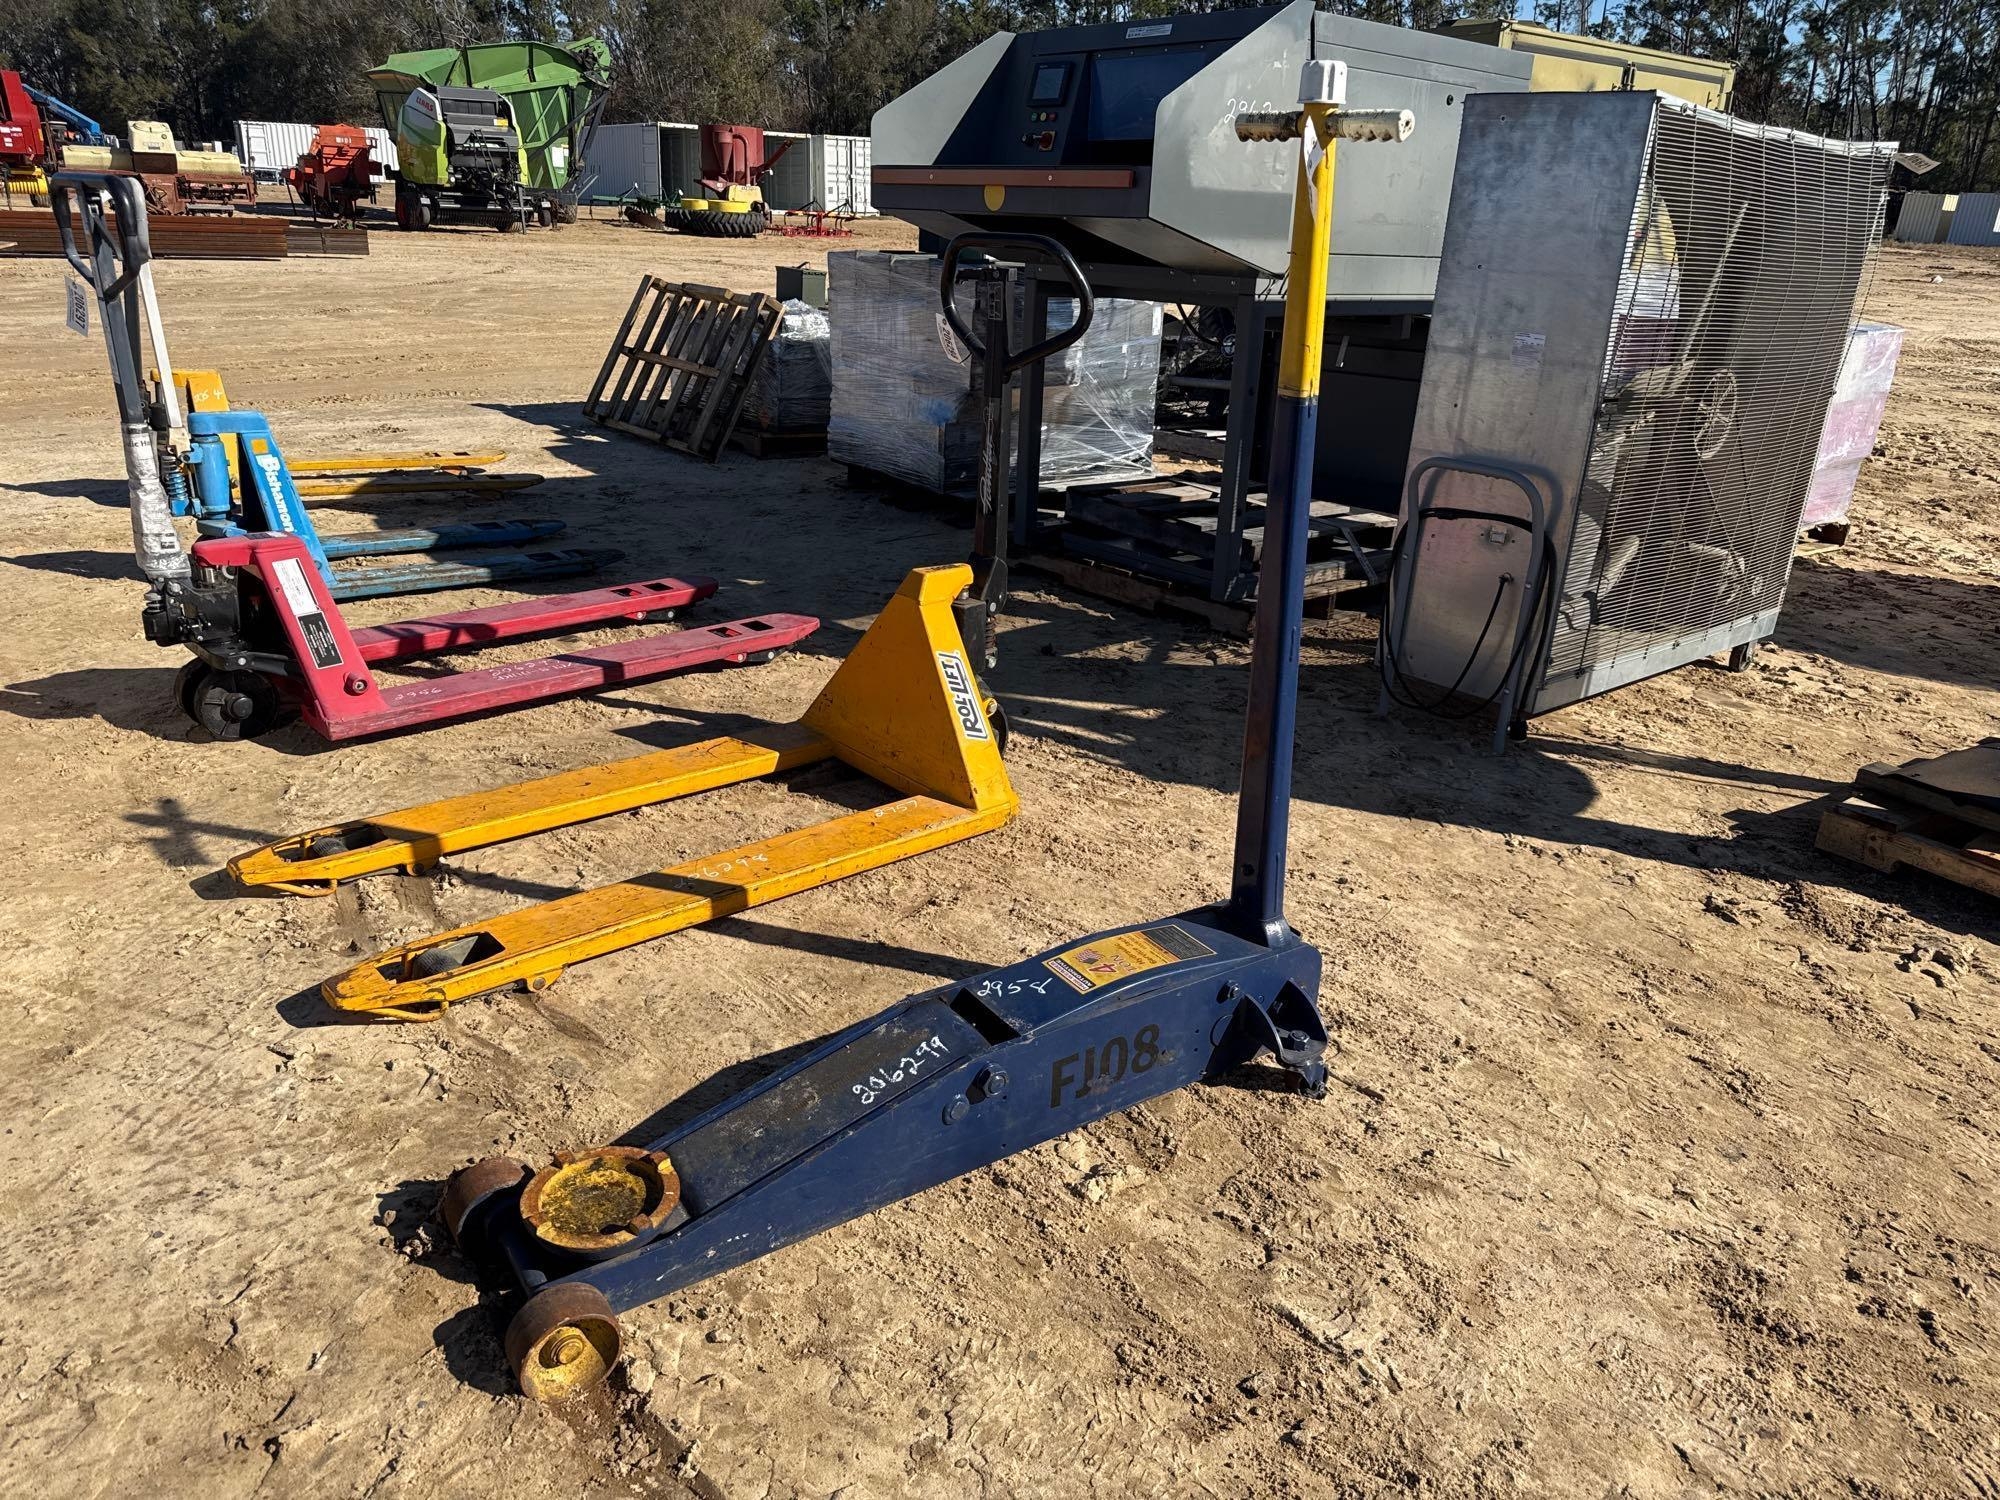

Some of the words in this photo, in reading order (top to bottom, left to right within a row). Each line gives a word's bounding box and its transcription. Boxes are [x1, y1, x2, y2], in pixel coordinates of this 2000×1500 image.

[255, 454, 295, 532] Bishamon
[874, 799, 918, 818] 2957
[673, 853, 768, 889] 206298
[1055, 960, 1093, 987] AUTOMOTIVE
[1088, 963, 1117, 973] 4
[976, 977, 1053, 998] 2958
[852, 1035, 950, 1105] 206299
